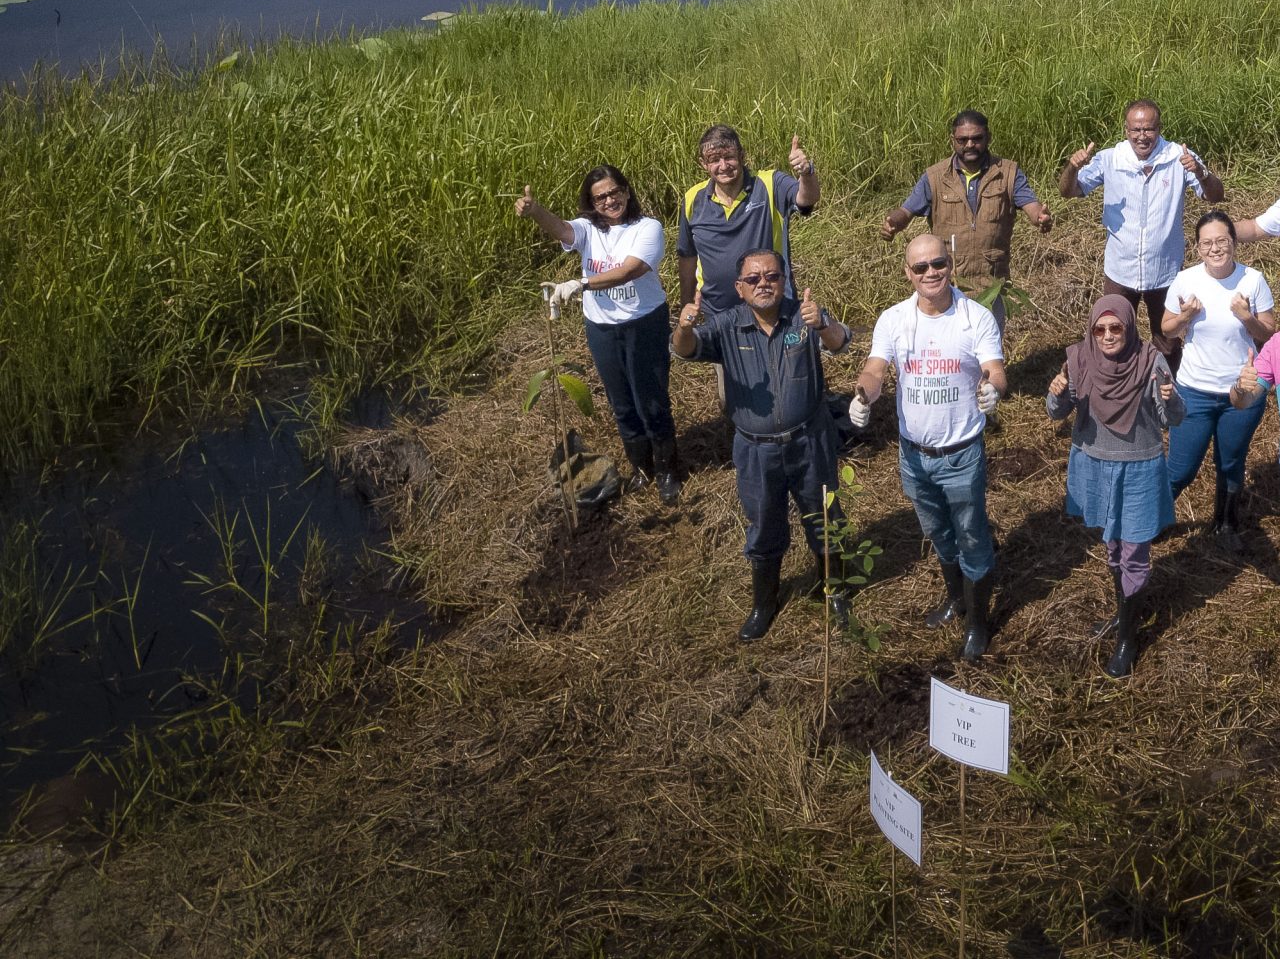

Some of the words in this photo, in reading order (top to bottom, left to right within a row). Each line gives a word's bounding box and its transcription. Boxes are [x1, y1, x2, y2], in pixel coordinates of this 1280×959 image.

[904, 359, 923, 375] ONE
[926, 358, 961, 375] SPARK
[914, 376, 921, 387] TO
[924, 376, 949, 387] CHANGE
[907, 387, 920, 405] THE
[923, 386, 959, 405] WORLD
[956, 717, 972, 731] VIP
[951, 732, 977, 749] TREE
[884, 798, 896, 810] VIP
[899, 824, 915, 841] SITE
